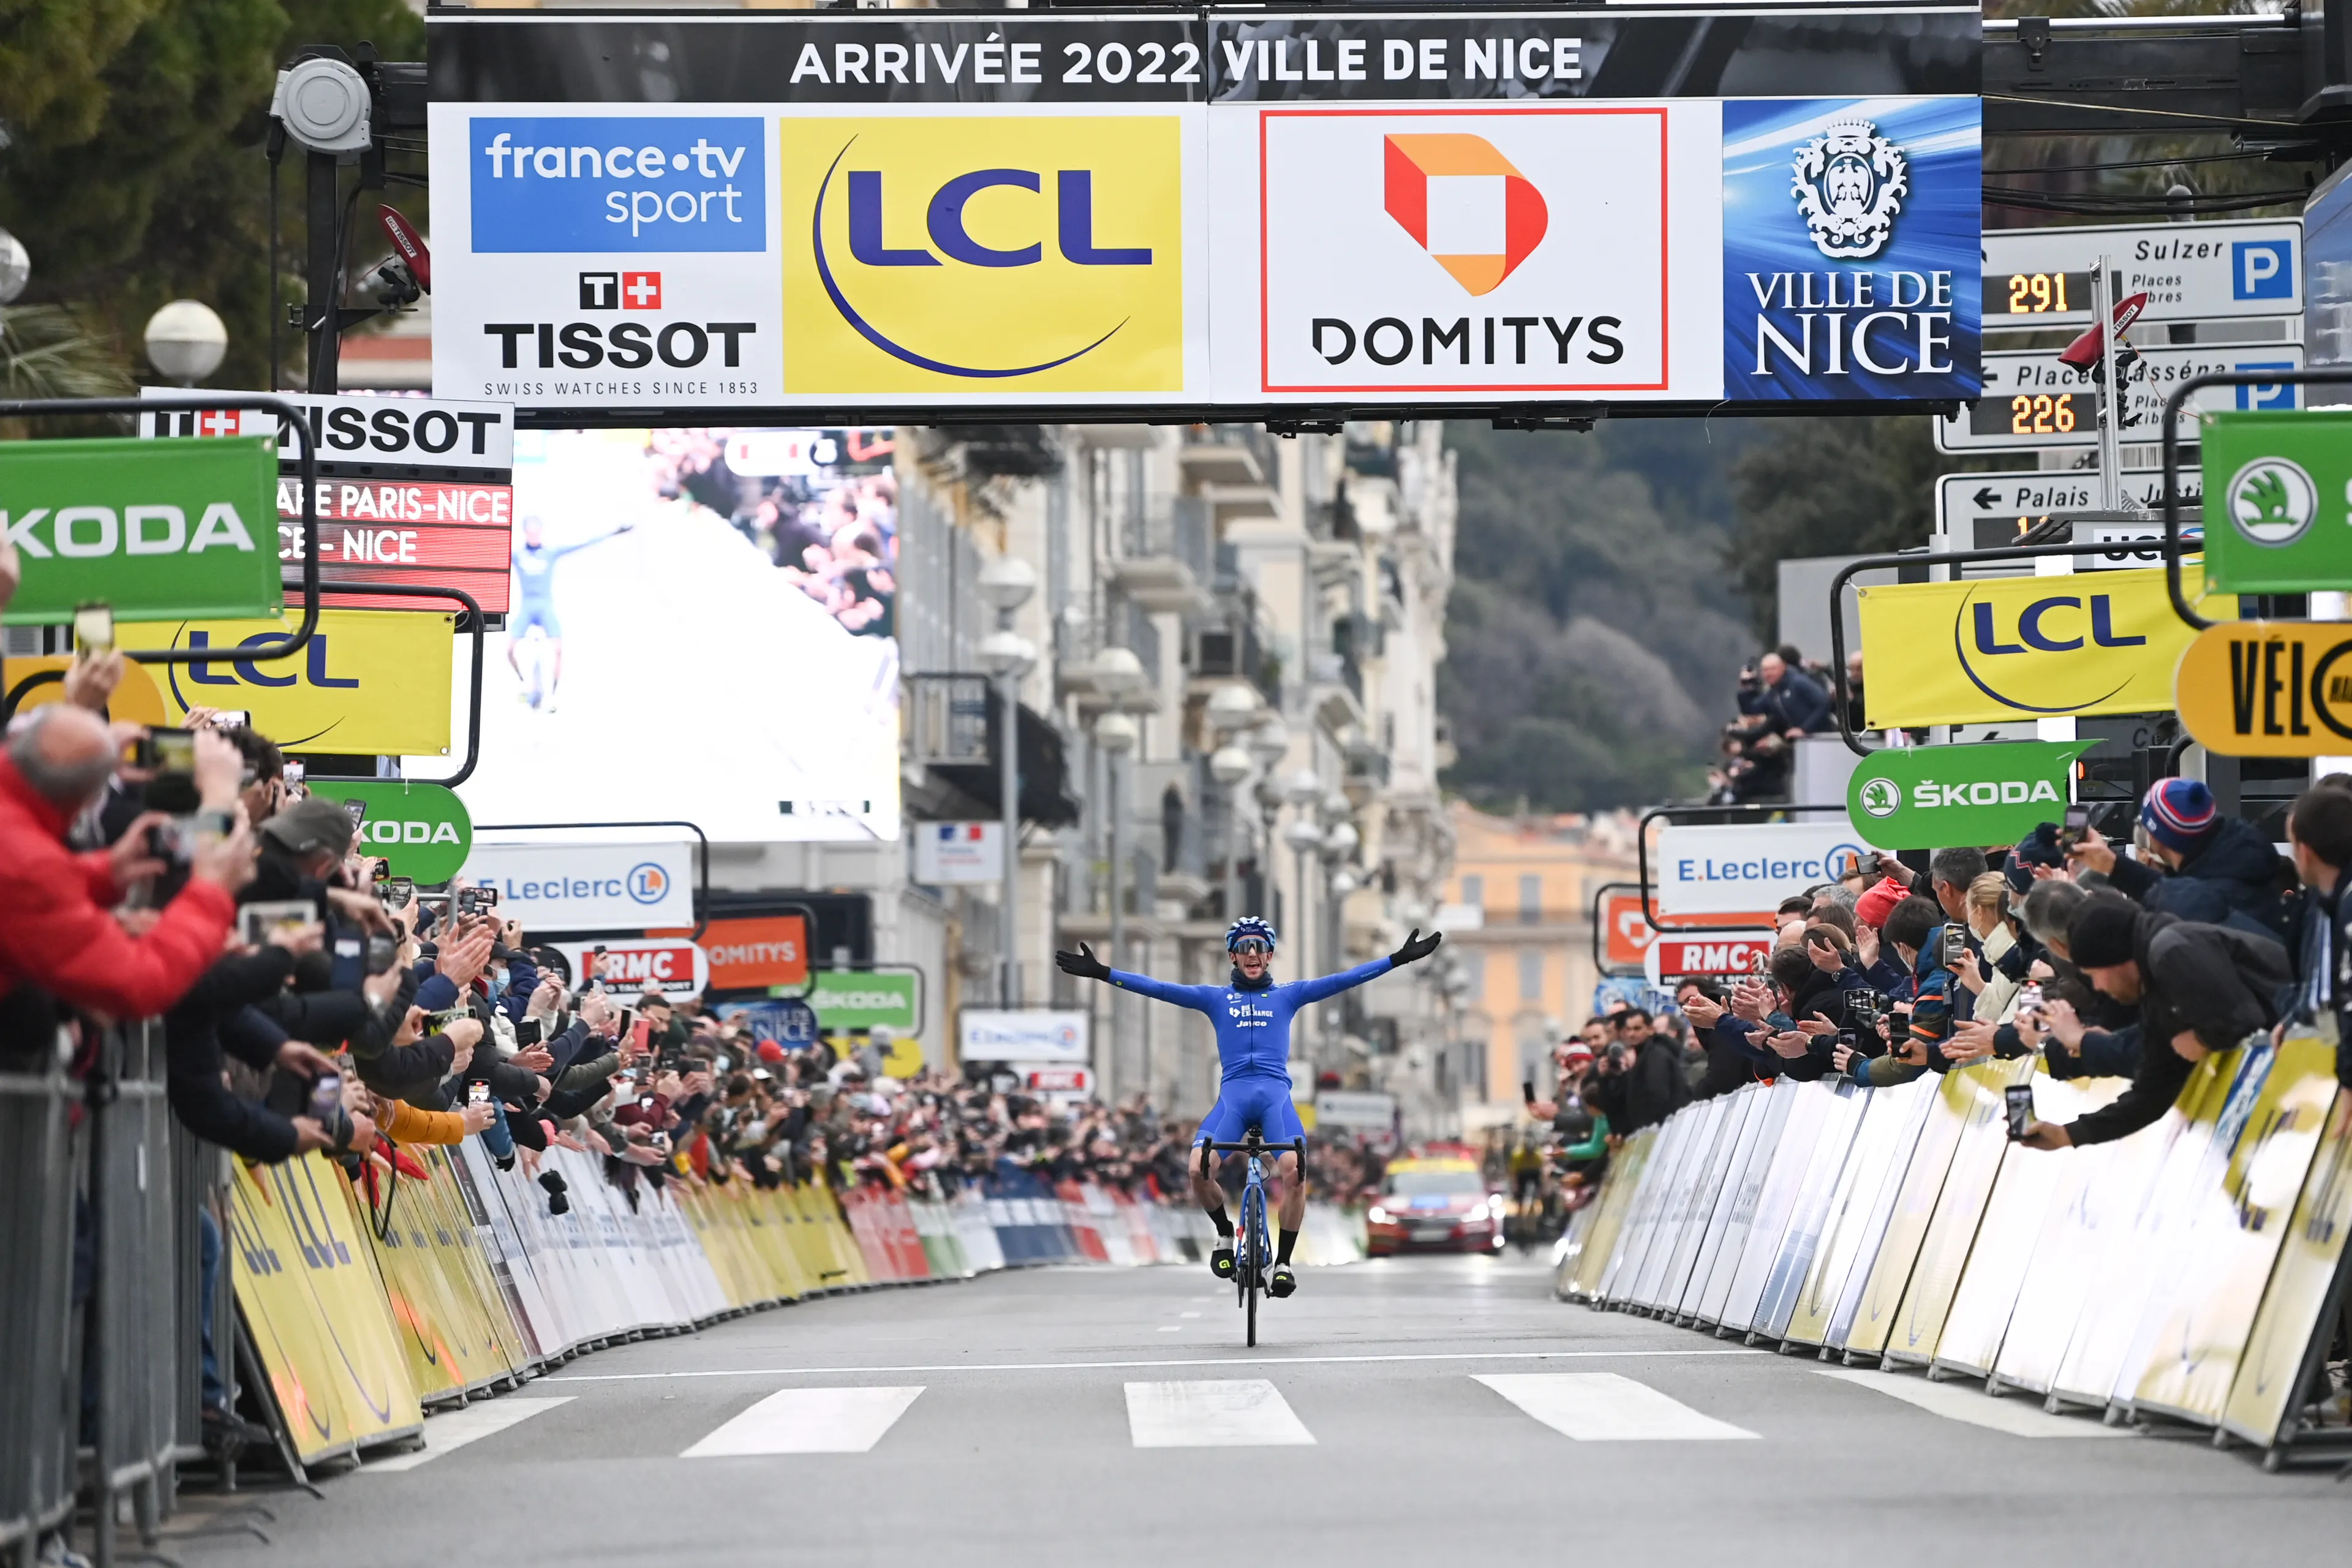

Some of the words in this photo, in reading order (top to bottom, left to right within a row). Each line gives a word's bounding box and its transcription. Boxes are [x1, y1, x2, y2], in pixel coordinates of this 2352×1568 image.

[790, 32, 1042, 83] ARRIVÉE
[1062, 42, 1200, 83] 2022
[1223, 39, 1366, 81] VILLE
[1384, 38, 1447, 80] DE
[1464, 37, 1582, 80] NICE
[605, 183, 742, 238] sport
[848, 168, 1152, 268] LCL
[394, 227, 415, 254] TISSOT
[2132, 273, 2182, 288] Places
[2135, 239, 2223, 262] Sulzer
[2244, 247, 2280, 294] P
[1744, 271, 1874, 309] VILLE
[1888, 270, 1953, 307] DE
[2008, 272, 2068, 314] 291
[2134, 290, 2182, 304] bres
[2113, 306, 2136, 333] TISSOT
[484, 322, 756, 369] TISSOT
[1312, 315, 1624, 366] DOMITYS
[1750, 311, 1953, 376] NICE
[484, 382, 544, 396] SWISS
[555, 382, 641, 395] WATCHES
[653, 382, 707, 395] SINCE
[719, 382, 758, 394] 1853
[2017, 365, 2090, 387] Place
[2125, 359, 2226, 382] asséna
[2012, 393, 2075, 435] 226
[2135, 395, 2185, 409] Placs
[262, 406, 501, 455] TISSOT
[341, 484, 509, 523] PARIS-NICE
[2016, 486, 2089, 508] Palais
[343, 529, 418, 563] NICE
[1972, 594, 2146, 655] LCL
[187, 630, 360, 688] LCL
[1913, 779, 2060, 809] ŠKODA
[1678, 858, 1821, 881] E.Leclerc
[605, 950, 675, 979] RMC
[1681, 943, 1750, 971] RMC
[810, 988, 907, 1010] ŠKODA
